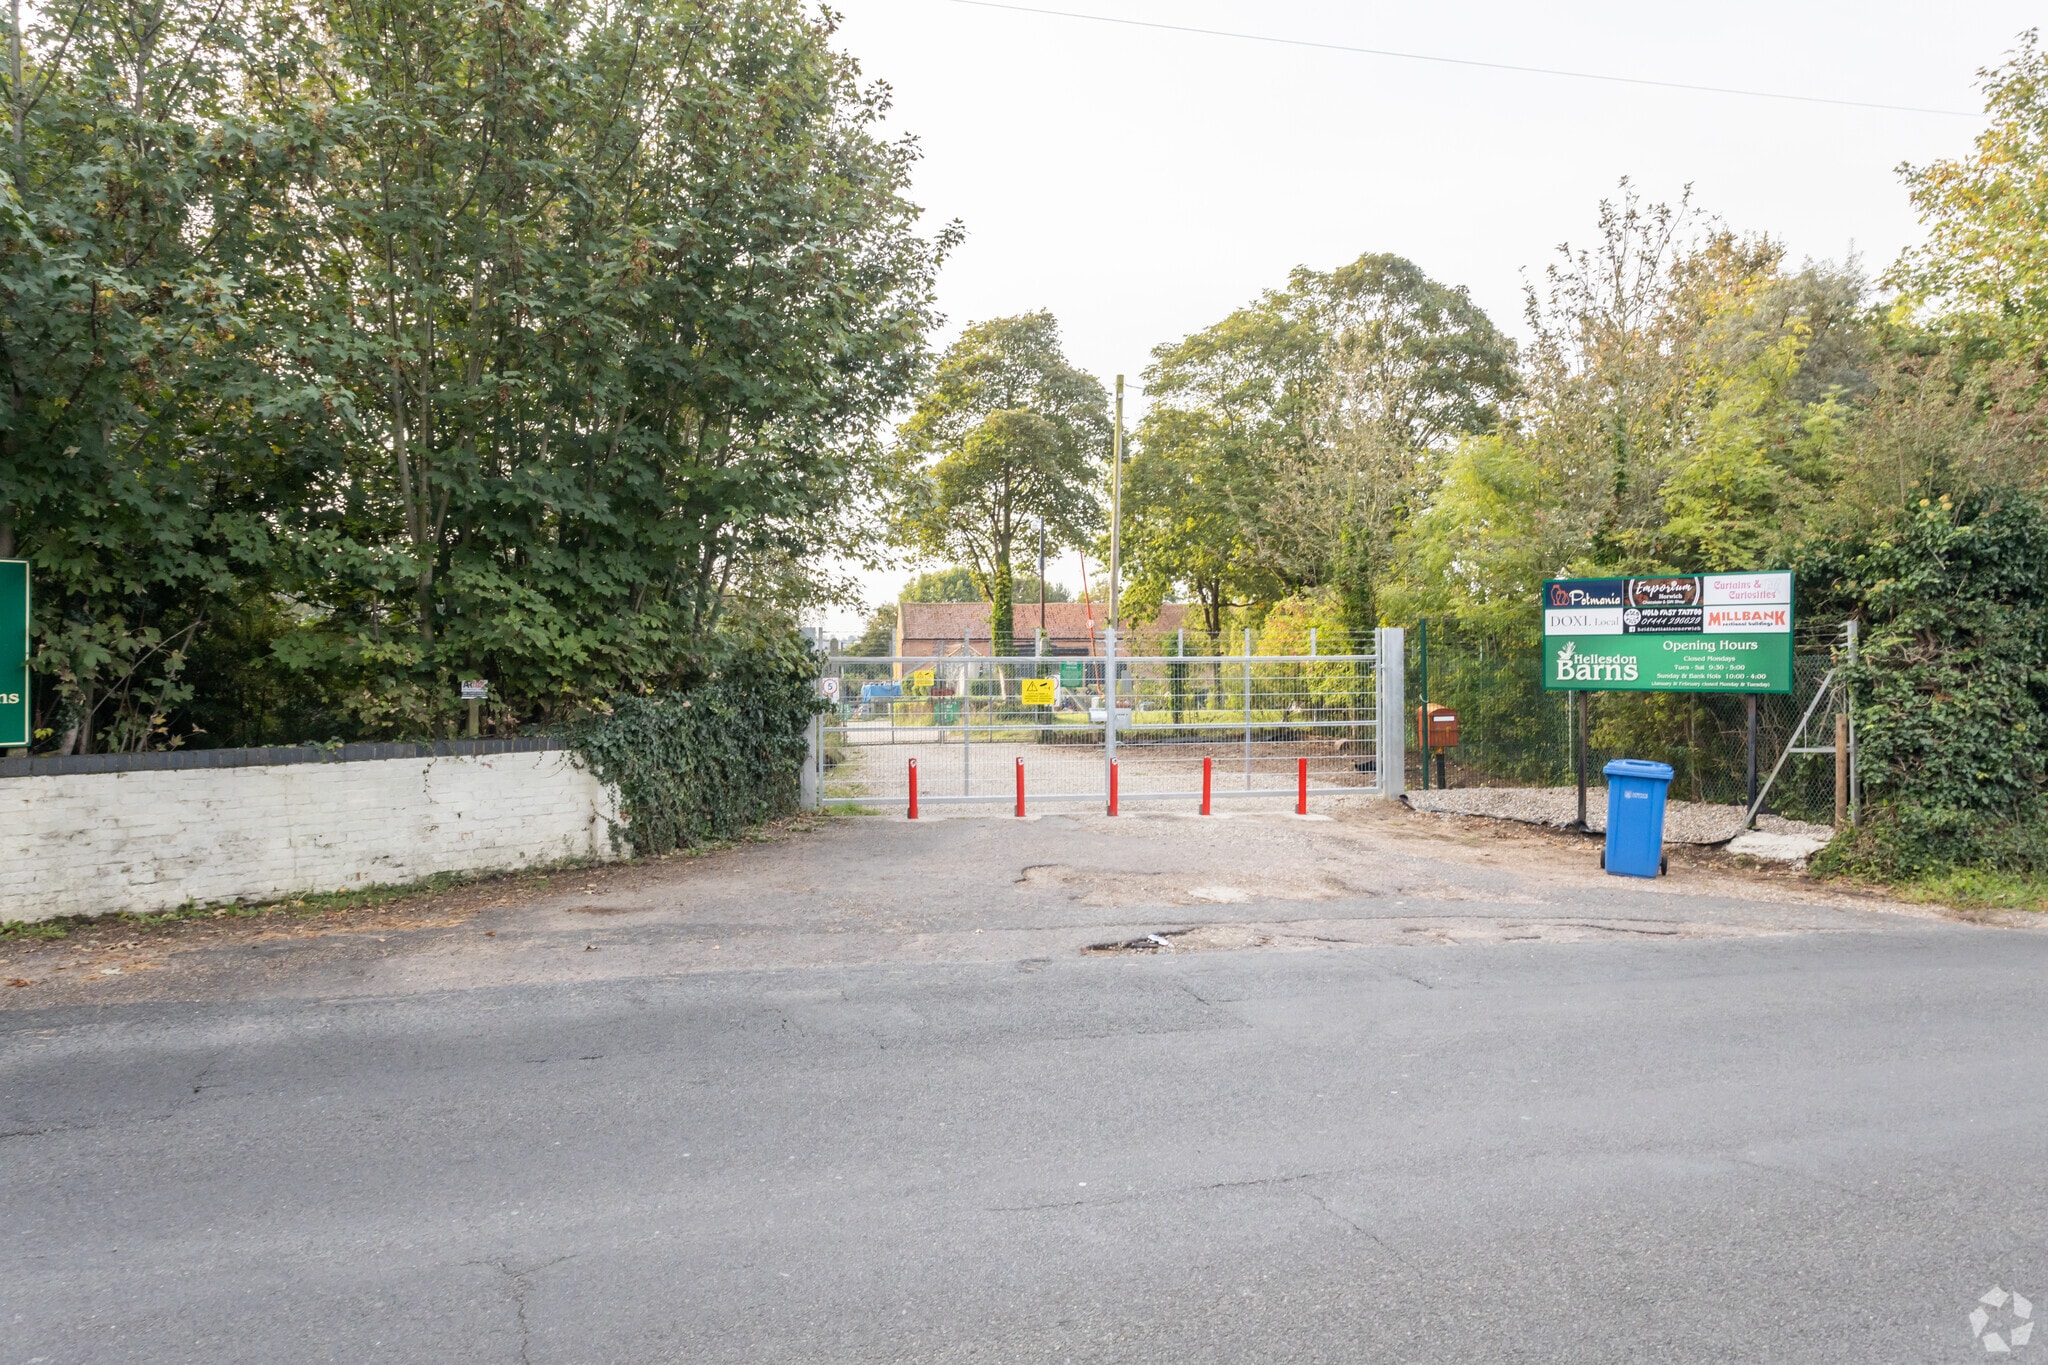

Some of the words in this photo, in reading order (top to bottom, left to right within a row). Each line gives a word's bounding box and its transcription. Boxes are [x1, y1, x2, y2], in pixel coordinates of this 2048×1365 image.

[1636, 580, 1692, 598] Emporium
[1714, 580, 1750, 590] Curtains
[1754, 580, 1761, 588] &
[1569, 590, 1620, 606] Potmania
[1728, 590, 1776, 600] Curiosities
[1594, 616, 1619, 626] Local
[1708, 610, 1785, 626] MILLBANK
[1663, 640, 1716, 652] Opening
[1720, 640, 1758, 650] Hours
[1574, 654, 1637, 664] Hellesdon
[1557, 660, 1638, 681] Barns
